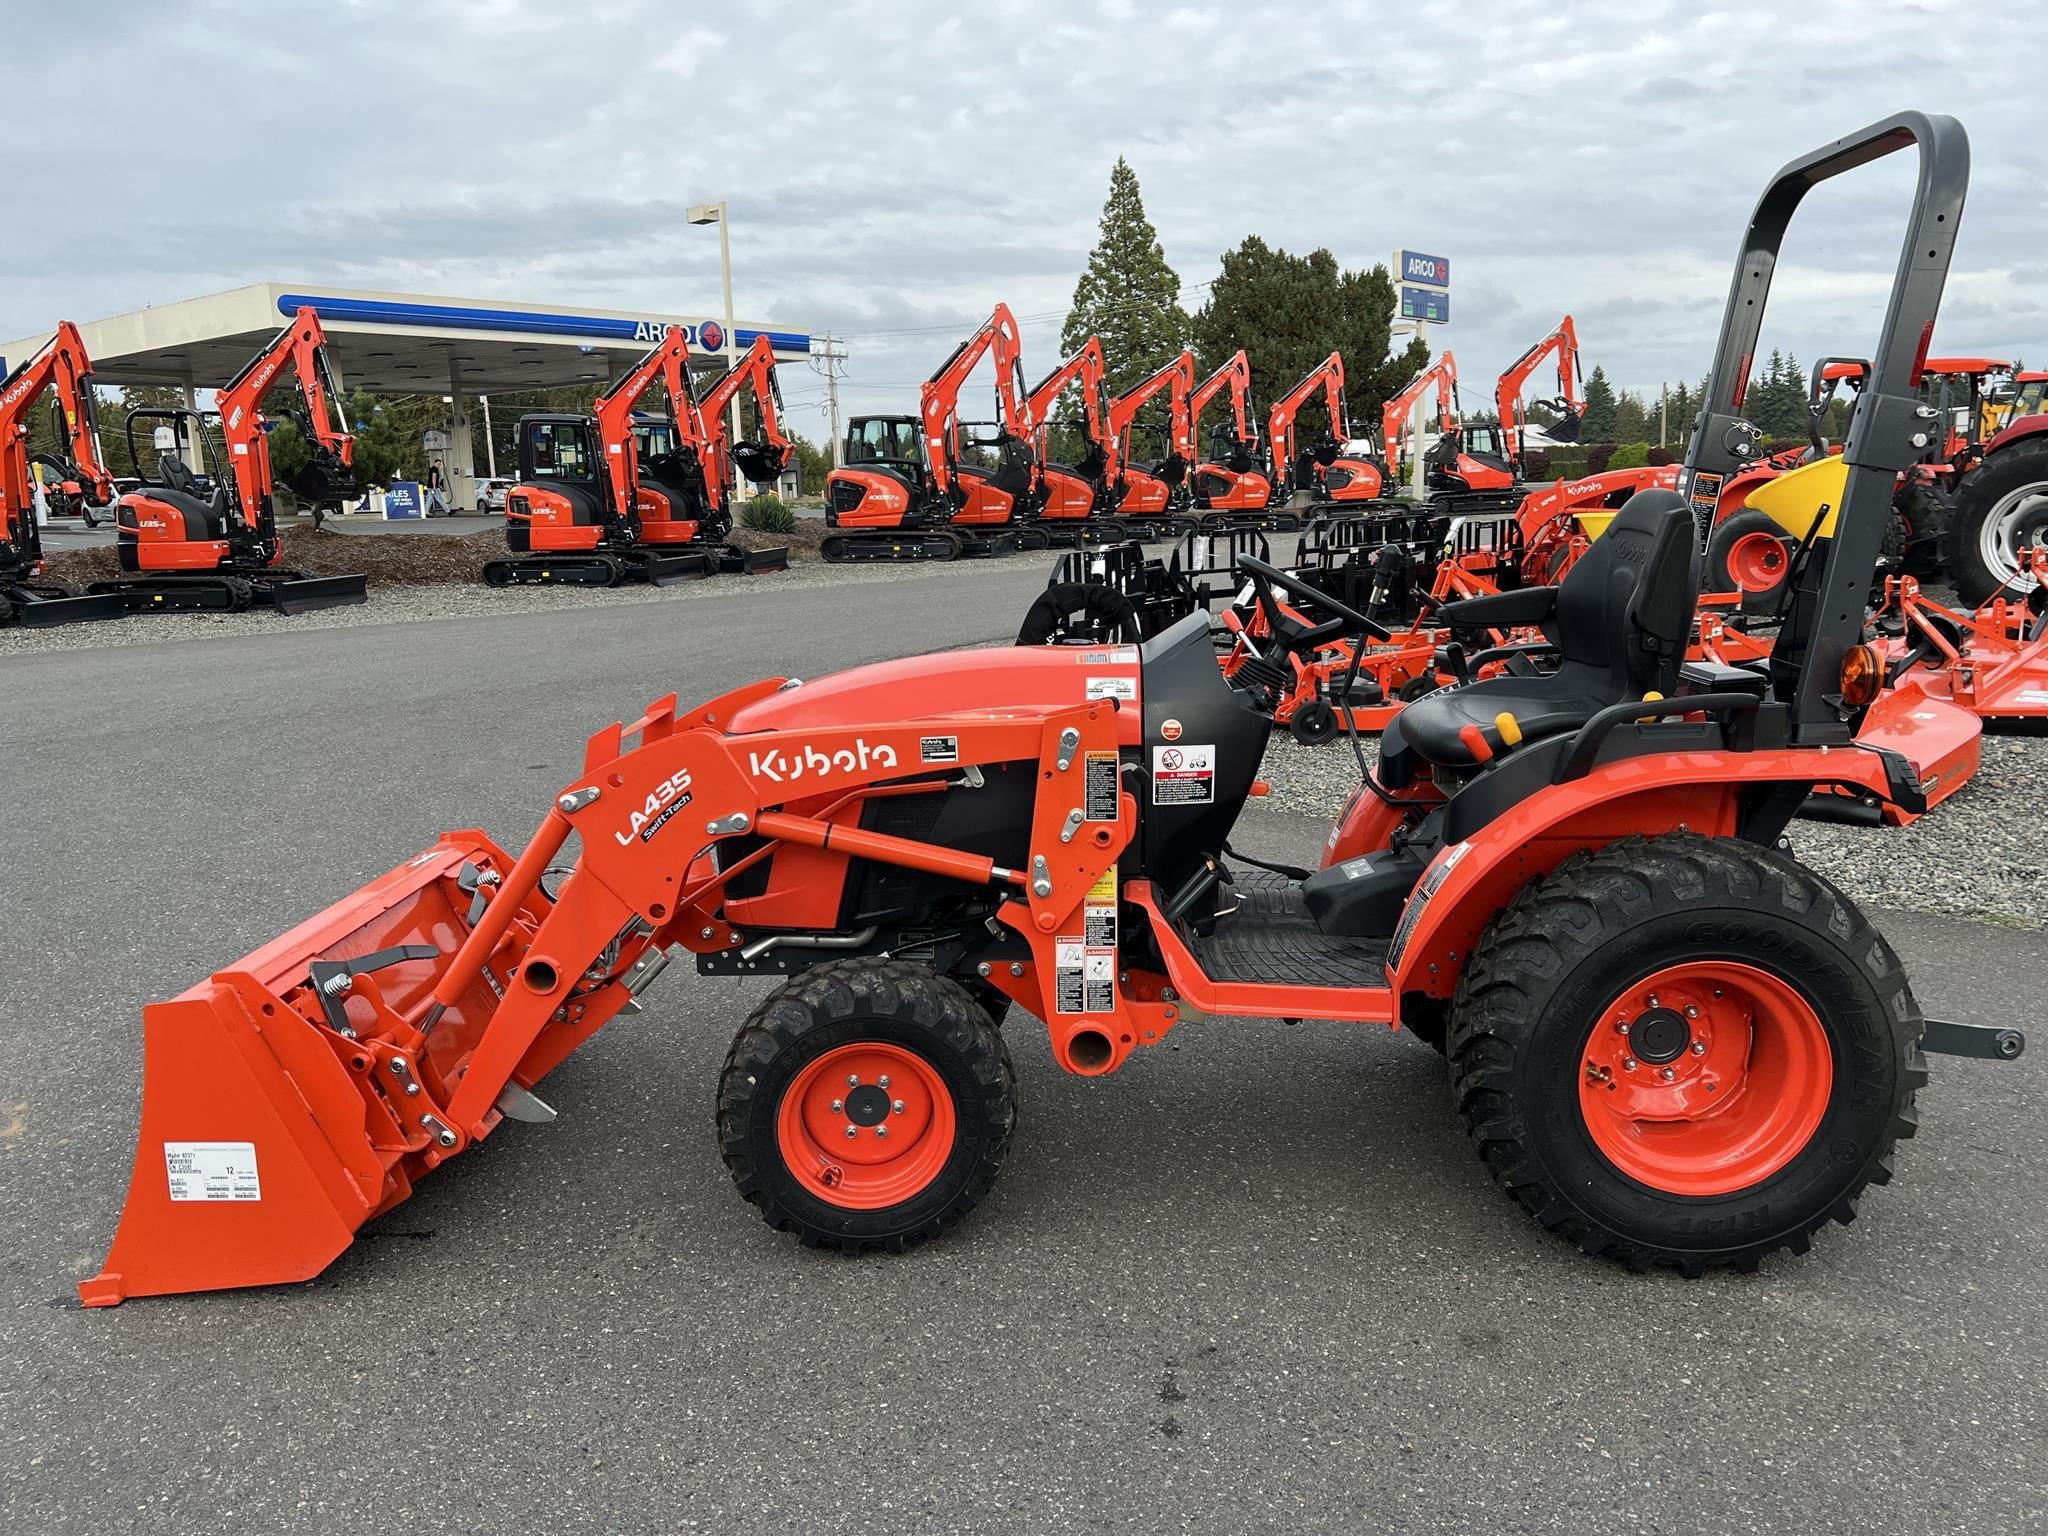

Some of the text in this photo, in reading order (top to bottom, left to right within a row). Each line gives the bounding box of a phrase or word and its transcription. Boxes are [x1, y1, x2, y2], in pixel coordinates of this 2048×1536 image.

[1408, 257, 1435, 277] ARCO
[252, 363, 275, 389] Kubota
[627, 375, 647, 398] Kubota
[3, 379, 33, 404] Kubota
[1568, 482, 1602, 496] Kubota
[749, 738, 898, 782] Kubota
[614, 768, 693, 846] LA435
[642, 794, 690, 840] Swift-Tach
[226, 1166, 234, 1175] 12
